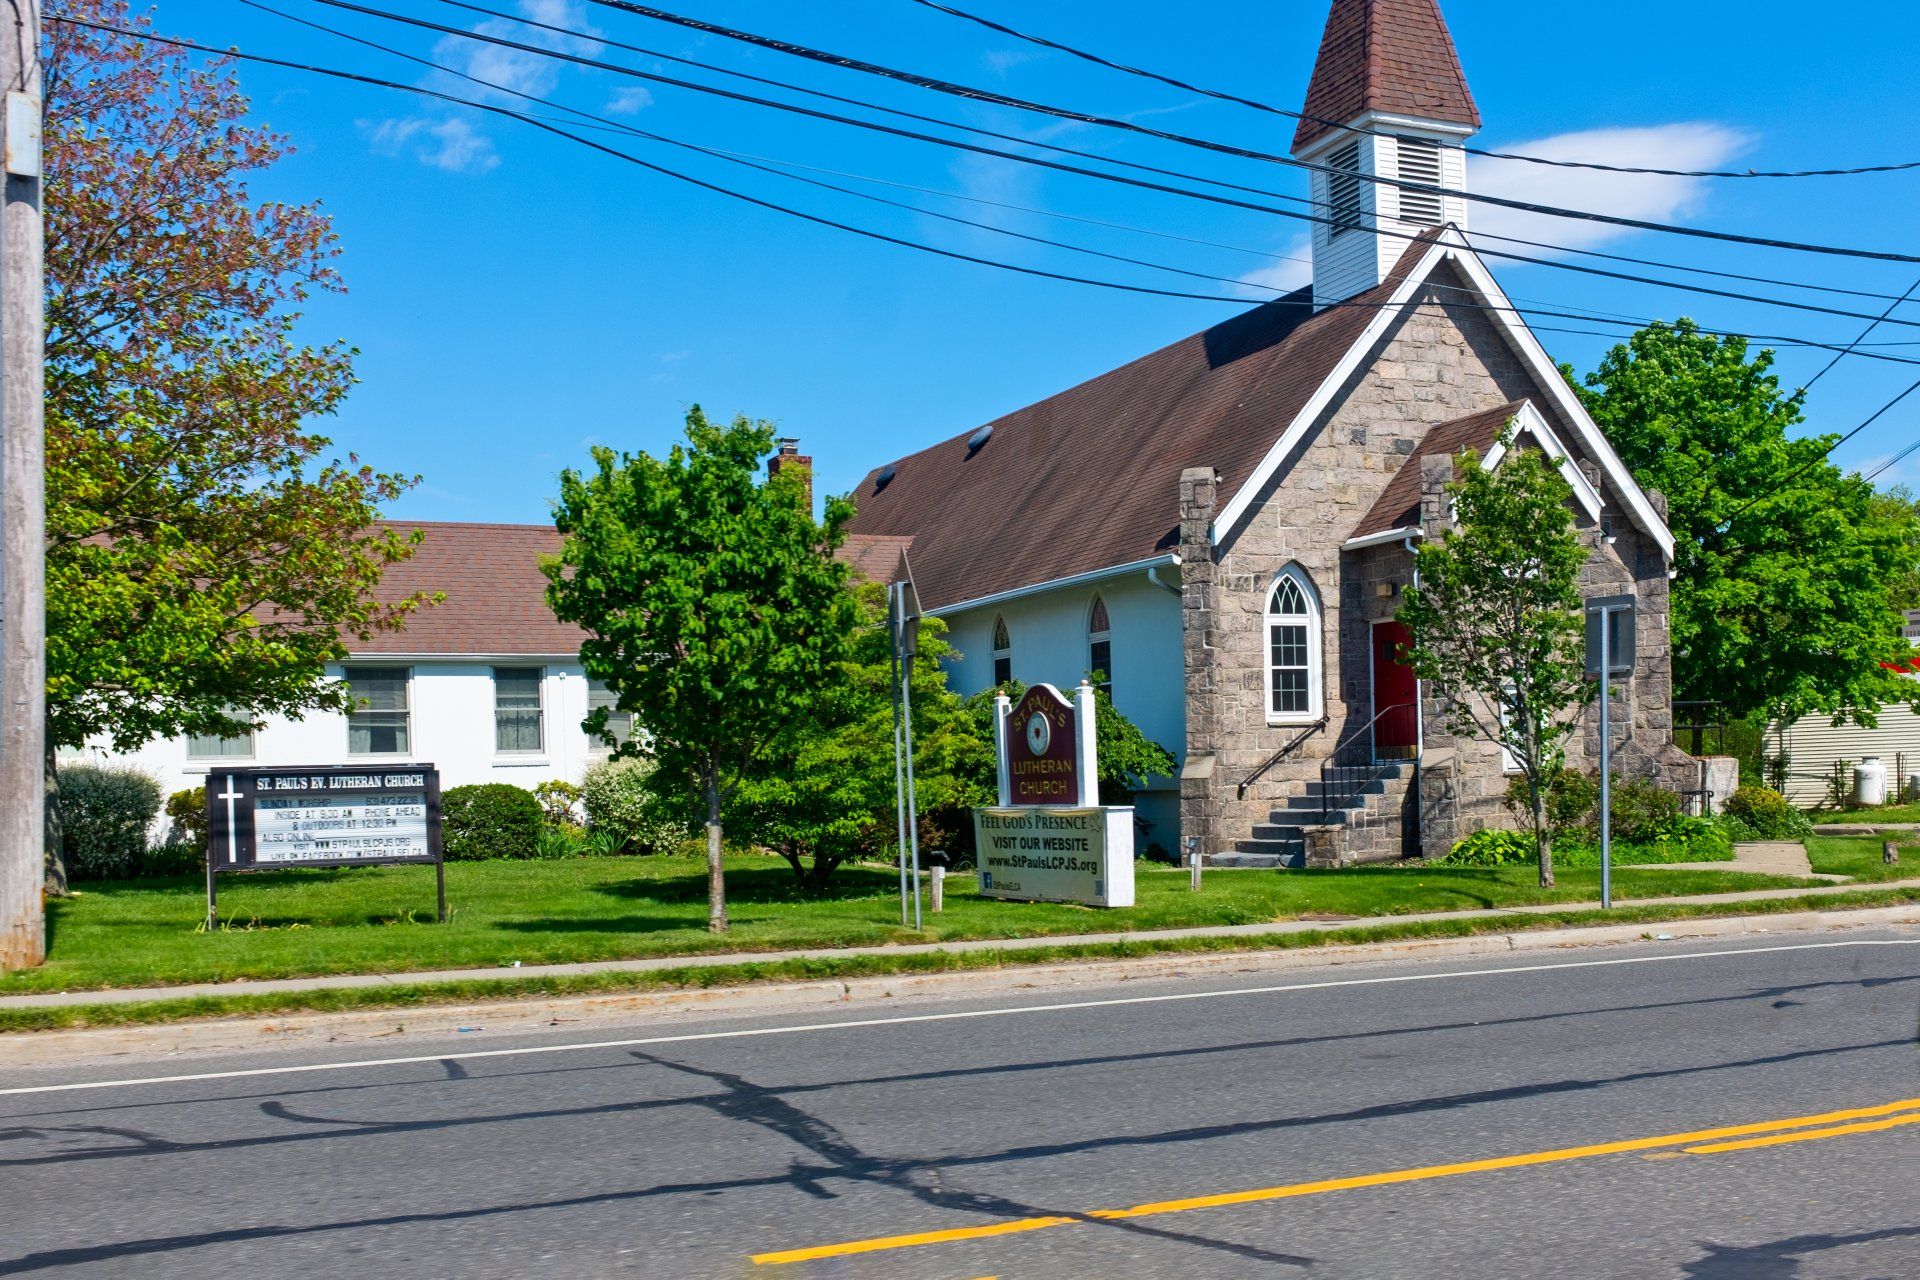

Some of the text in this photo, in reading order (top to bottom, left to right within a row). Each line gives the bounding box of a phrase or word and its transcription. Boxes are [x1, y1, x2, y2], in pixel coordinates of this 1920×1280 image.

[1014, 695, 1066, 731] ST. PAUL'S
[1013, 760, 1072, 775] LUTHERAN
[257, 774, 424, 790] ST. PAUL'S EV. LUTHERAN CHURCH
[1020, 780, 1067, 794] CHURCH
[261, 799, 292, 809] SUNDAY
[298, 798, 332, 808] WORSHIP
[275, 810, 300, 820] INSIDE
[305, 810, 315, 819] AT
[343, 809, 352, 818] AM
[365, 808, 390, 817] PHONE
[395, 807, 420, 817] AHEAD
[302, 820, 344, 830] OUTDOORS
[347, 819, 356, 829] AT
[386, 818, 397, 827] PM
[981, 814, 1087, 830] FEEL GOD'S PRESENCE
[263, 832, 315, 842] ALSO ONLINE
[993, 836, 1089, 851] VISIT OUR WEBSITE
[988, 855, 1098, 875] www.StPaulsLCPJS.org
